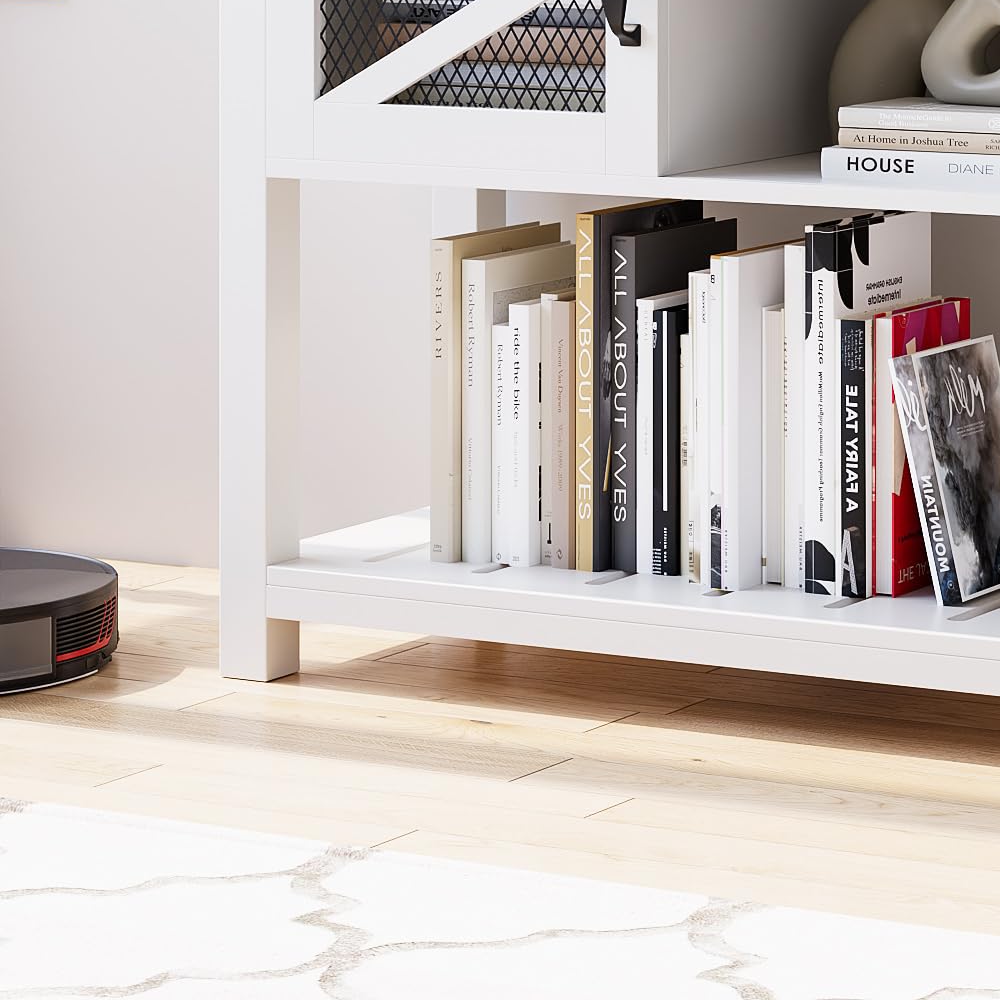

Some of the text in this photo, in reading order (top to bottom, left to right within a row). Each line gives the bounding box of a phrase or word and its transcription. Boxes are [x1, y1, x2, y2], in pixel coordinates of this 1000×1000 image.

[853, 134, 969, 148] At Home in Joshua Tree
[847, 156, 915, 174] HOUSE
[948, 162, 994, 176] DIANE
[434, 270, 444, 360] RIVERS
[466, 284, 476, 388] Robert Ryman
[513, 327, 521, 356] ride
[513, 361, 521, 384] the
[578, 228, 592, 522] ALL ABOUT YVES
[613, 248, 628, 524] ALL ABOUT YVES
[513, 389, 521, 421] bike
